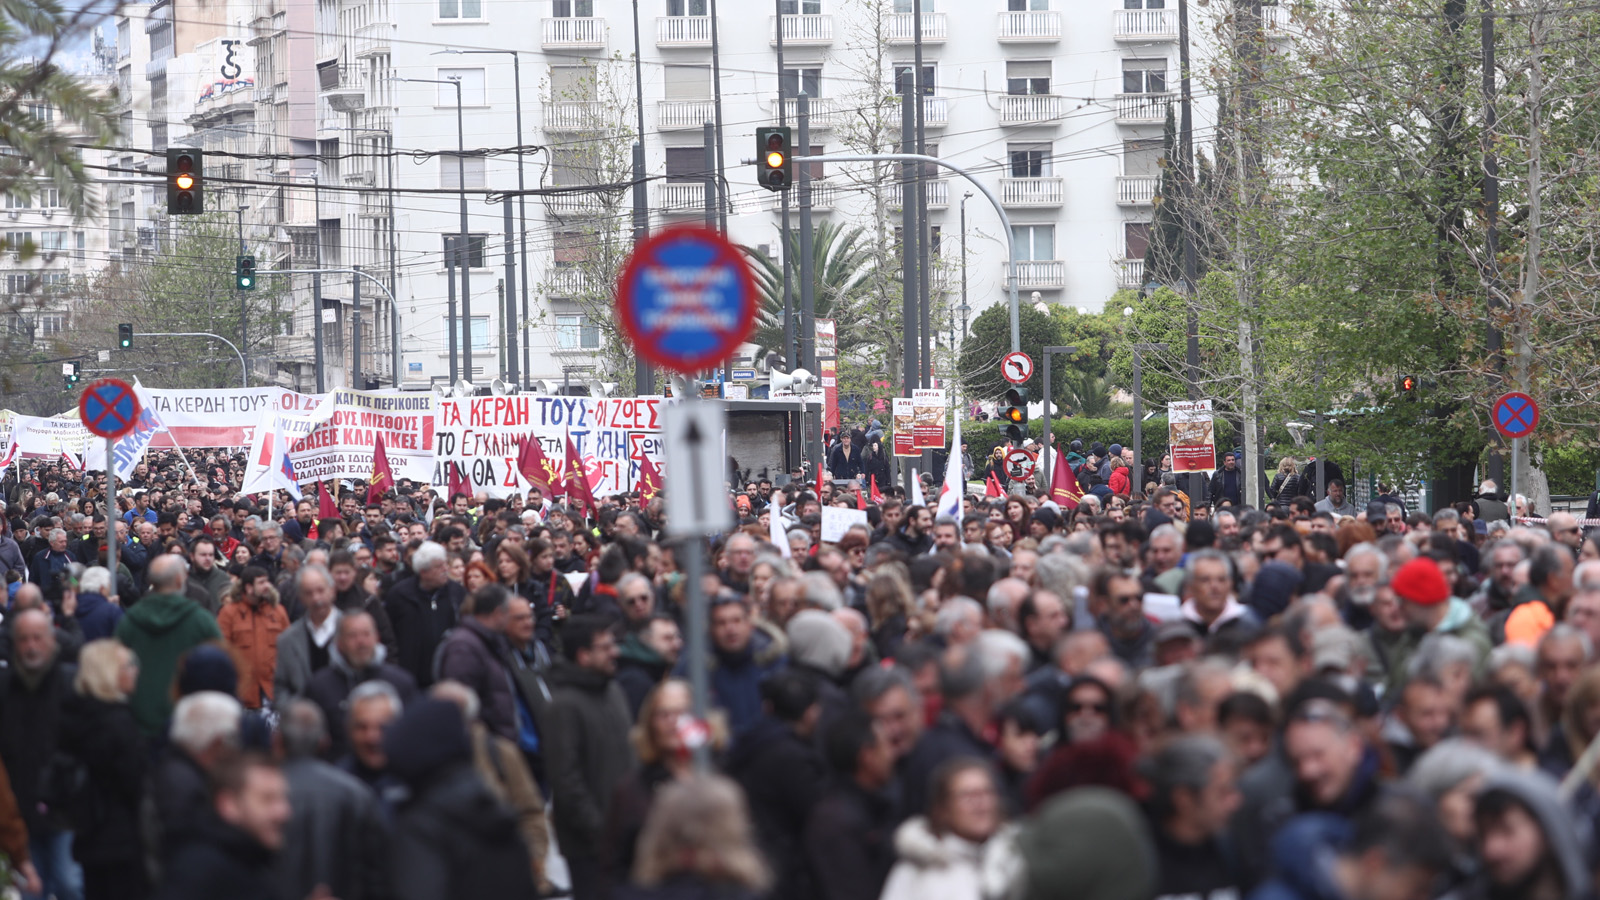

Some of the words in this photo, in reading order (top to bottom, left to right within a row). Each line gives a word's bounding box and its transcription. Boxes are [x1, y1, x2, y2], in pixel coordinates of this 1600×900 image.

[152, 395, 171, 412] ΤΑ
[175, 396, 225, 412] ΚΕΡΔΗ
[230, 394, 269, 412] ΤΟΥΣ
[281, 393, 300, 411] ΟΙ
[336, 392, 354, 405] ΚΑΙ
[356, 394, 372, 408] ΤΙΣ
[374, 397, 430, 411] ΠΕΡΙΚΟΠΕΣ
[361, 412, 418, 431] ΜΙΣΘΟΥΣ
[441, 401, 463, 426] ΤΑ
[470, 397, 529, 427] ΚΕΡΔΗ
[293, 421, 311, 433] ΣΤΑ
[285, 428, 339, 454] ΒΑΣΕΙΣ
[343, 428, 418, 450] ΚΛΑΙΚΕΣ
[436, 432, 455, 456] ΤΟ
[461, 429, 522, 457] ΕΓΚΛΗΜ
[570, 430, 627, 461] ΤΠΗ
[291, 454, 345, 470] ΟΣΠΟΝΔΙΑ
[349, 454, 408, 466] ΙΔΙΩΚΩΝ
[295, 465, 345, 480] ΠΑΛΛΗΛΩΝ
[349, 465, 401, 476] ΕΛΛΟΣ
[472, 459, 497, 487] ΘΑ
